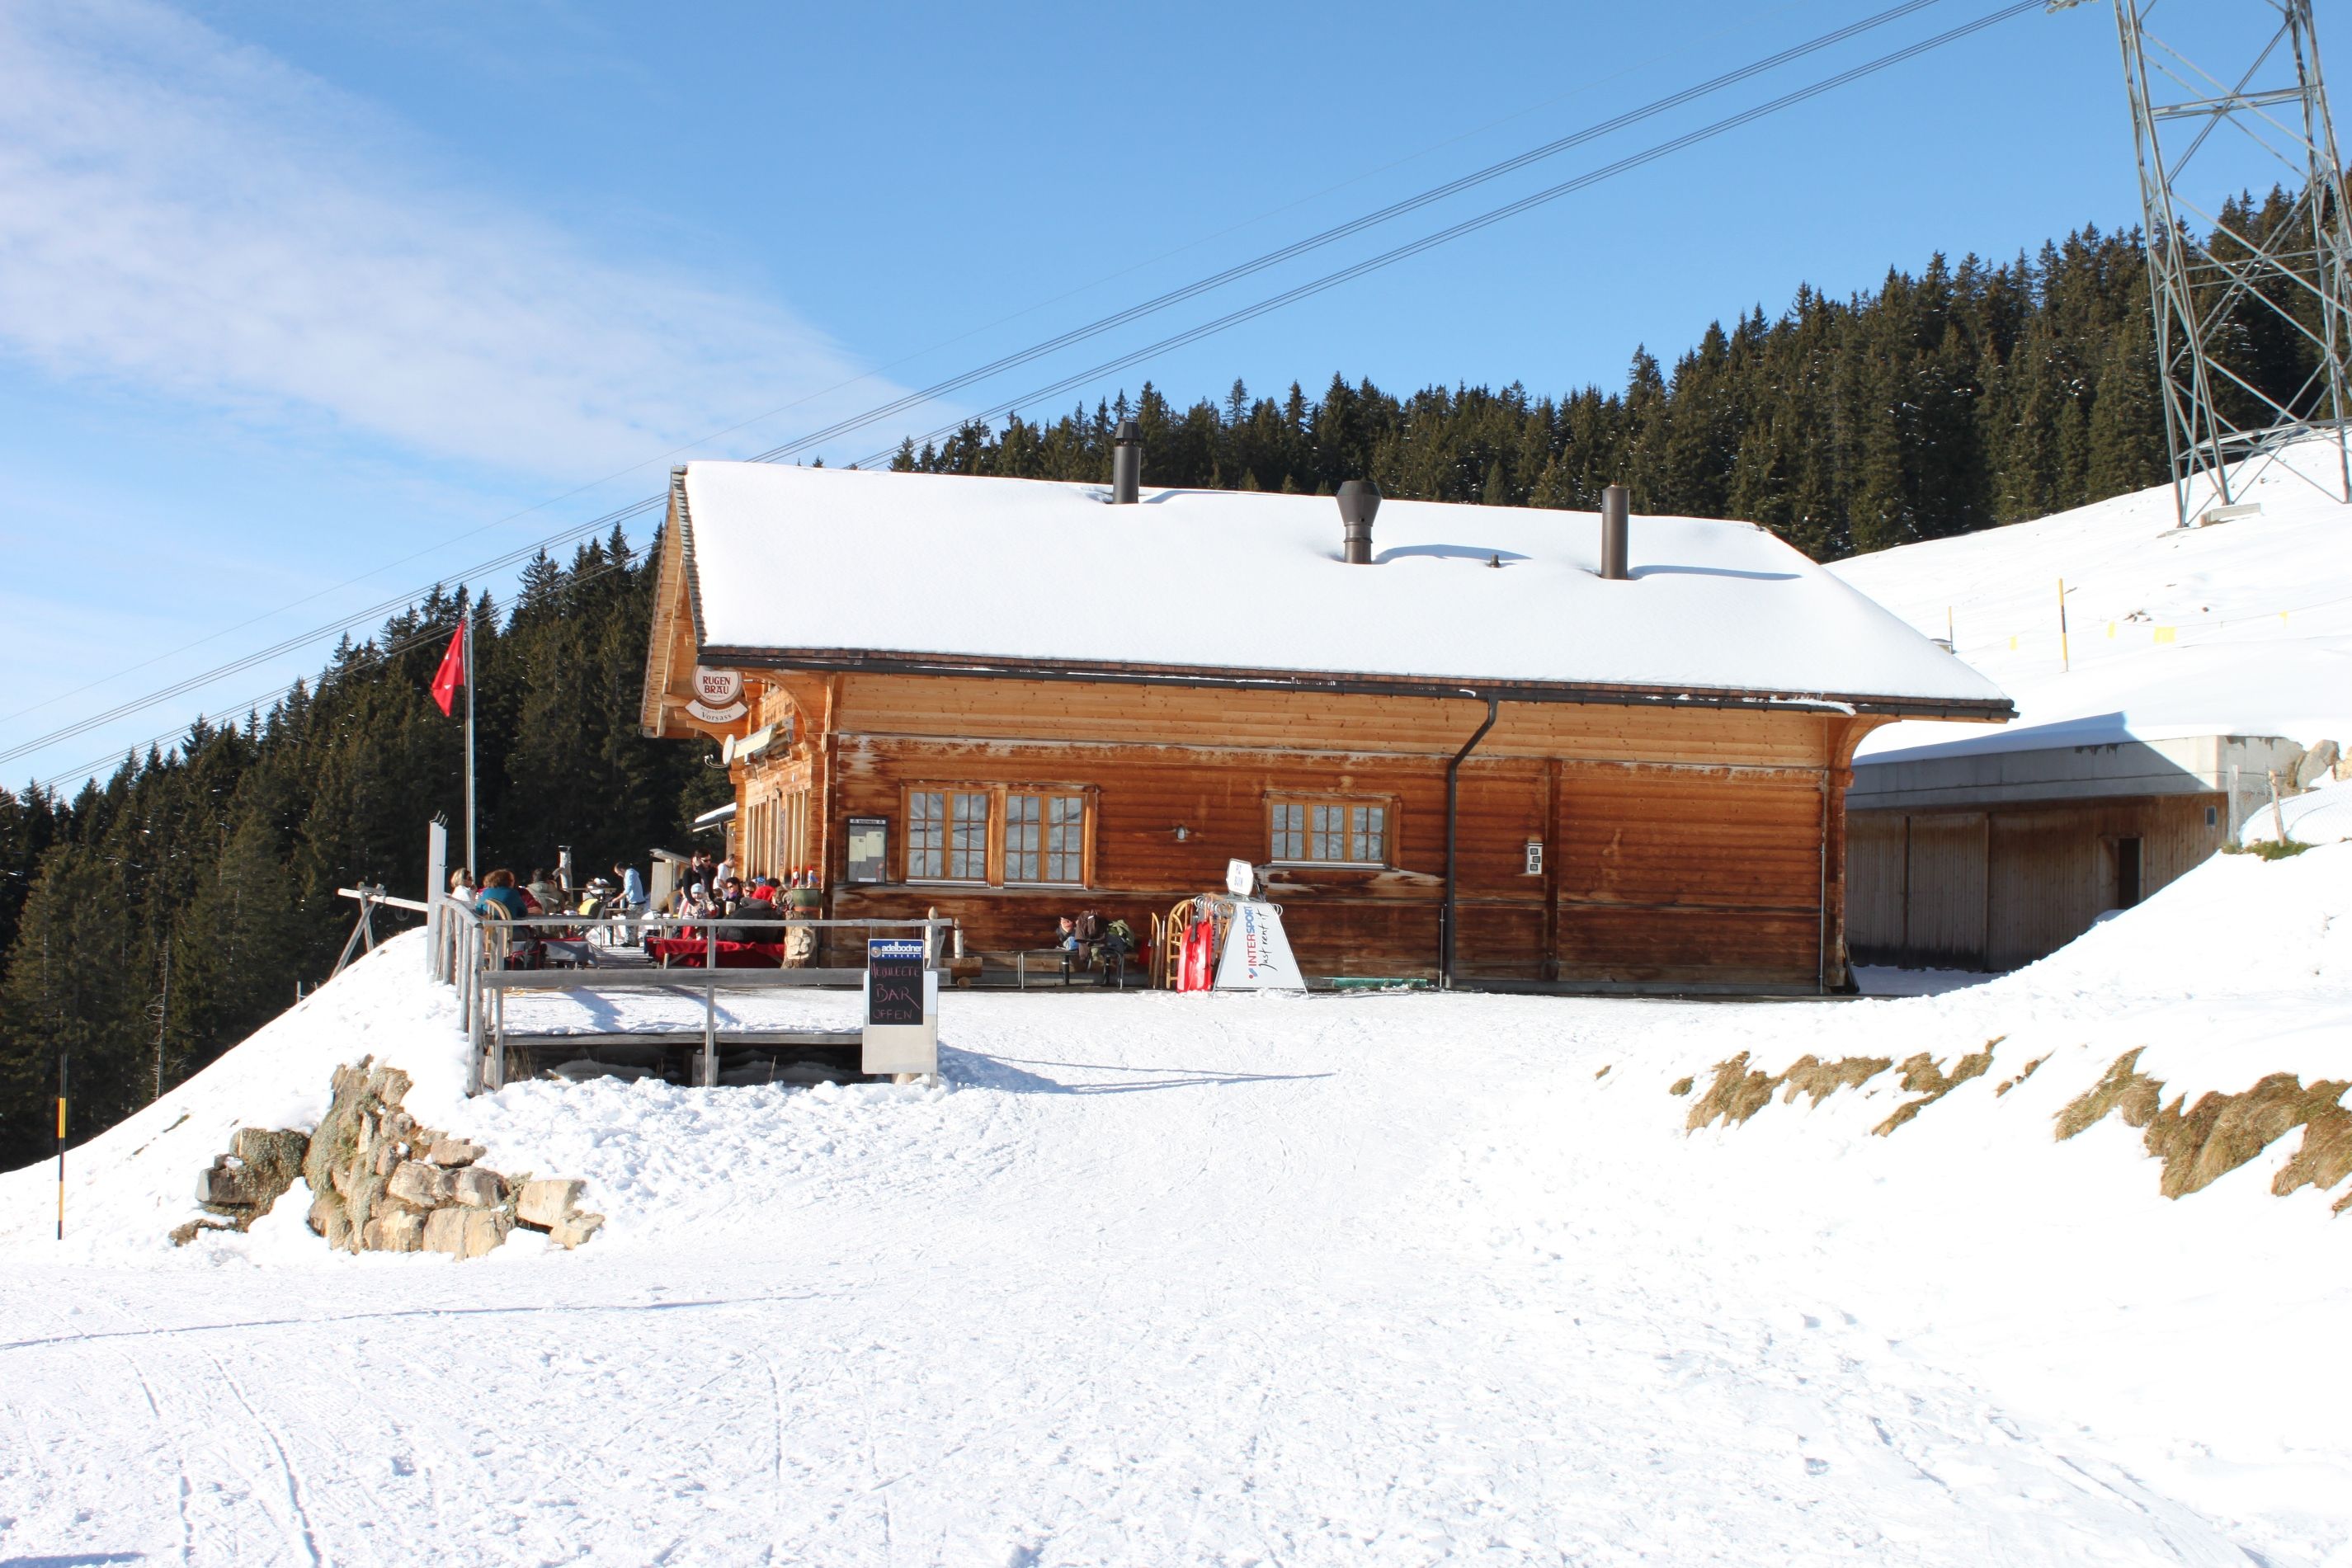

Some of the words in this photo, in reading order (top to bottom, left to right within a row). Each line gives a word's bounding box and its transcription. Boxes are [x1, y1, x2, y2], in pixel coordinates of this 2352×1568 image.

[703, 676, 731, 685] RUGEN
[702, 711, 733, 721] Vorsass
[1256, 907, 1270, 920] it
[1243, 906, 1257, 967] INTERSPORT
[1257, 923, 1270, 945] rent
[882, 941, 922, 953] adelbodner
[874, 983, 921, 1010] BAR
[872, 1010, 912, 1019] OFFEN
